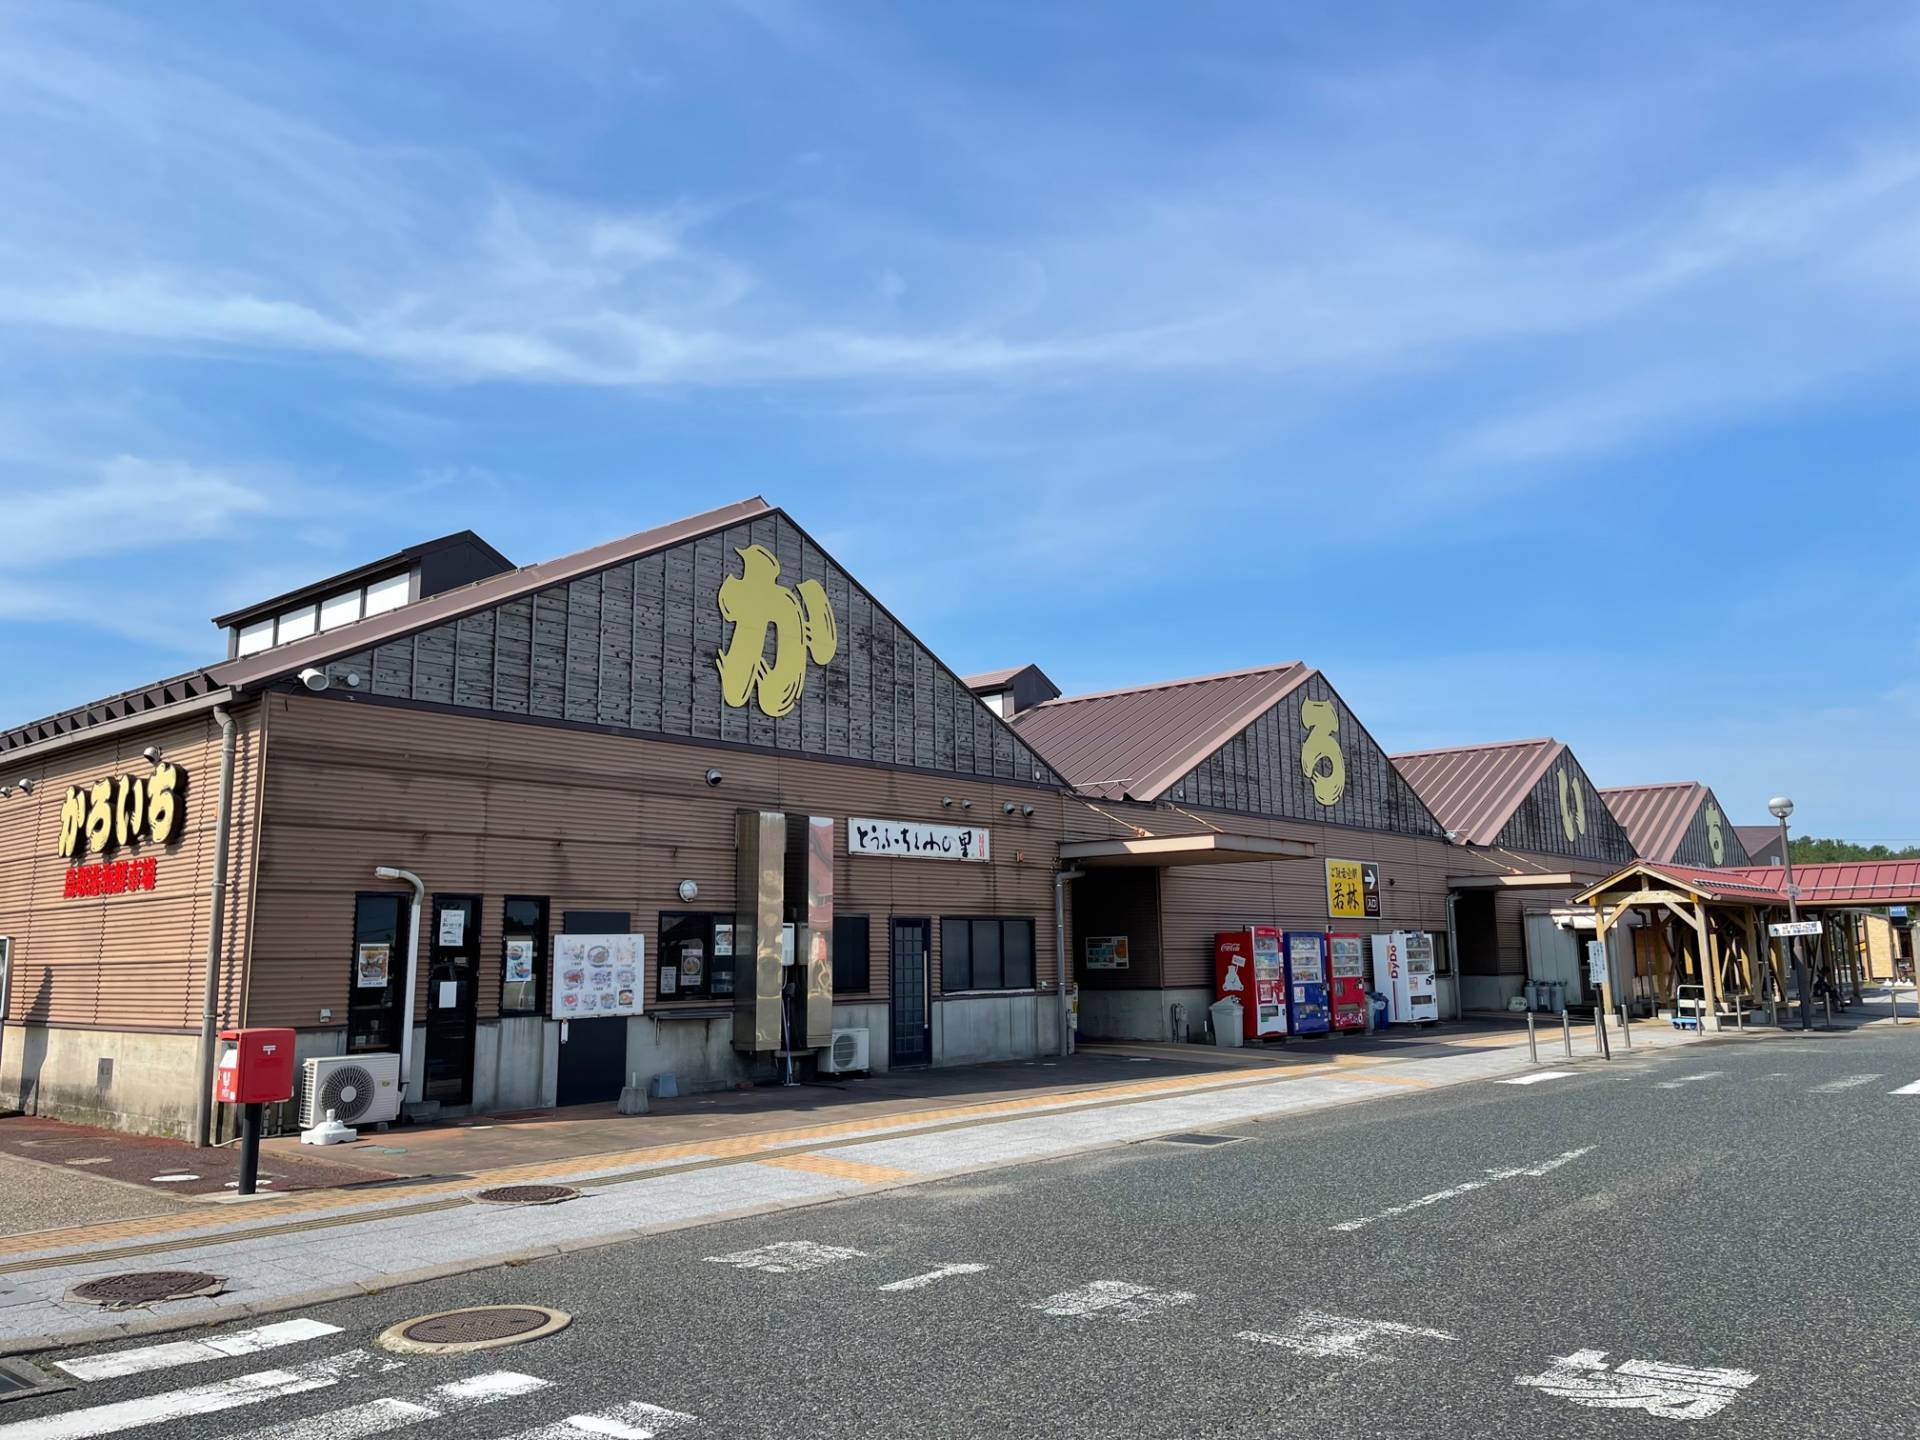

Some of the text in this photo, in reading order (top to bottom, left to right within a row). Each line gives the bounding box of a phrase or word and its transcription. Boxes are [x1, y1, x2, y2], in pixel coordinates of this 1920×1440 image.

[716, 544, 837, 717] か
[58, 761, 180, 857] かろいち
[1557, 767, 1585, 842] い
[1390, 945, 1400, 979] DyDo
